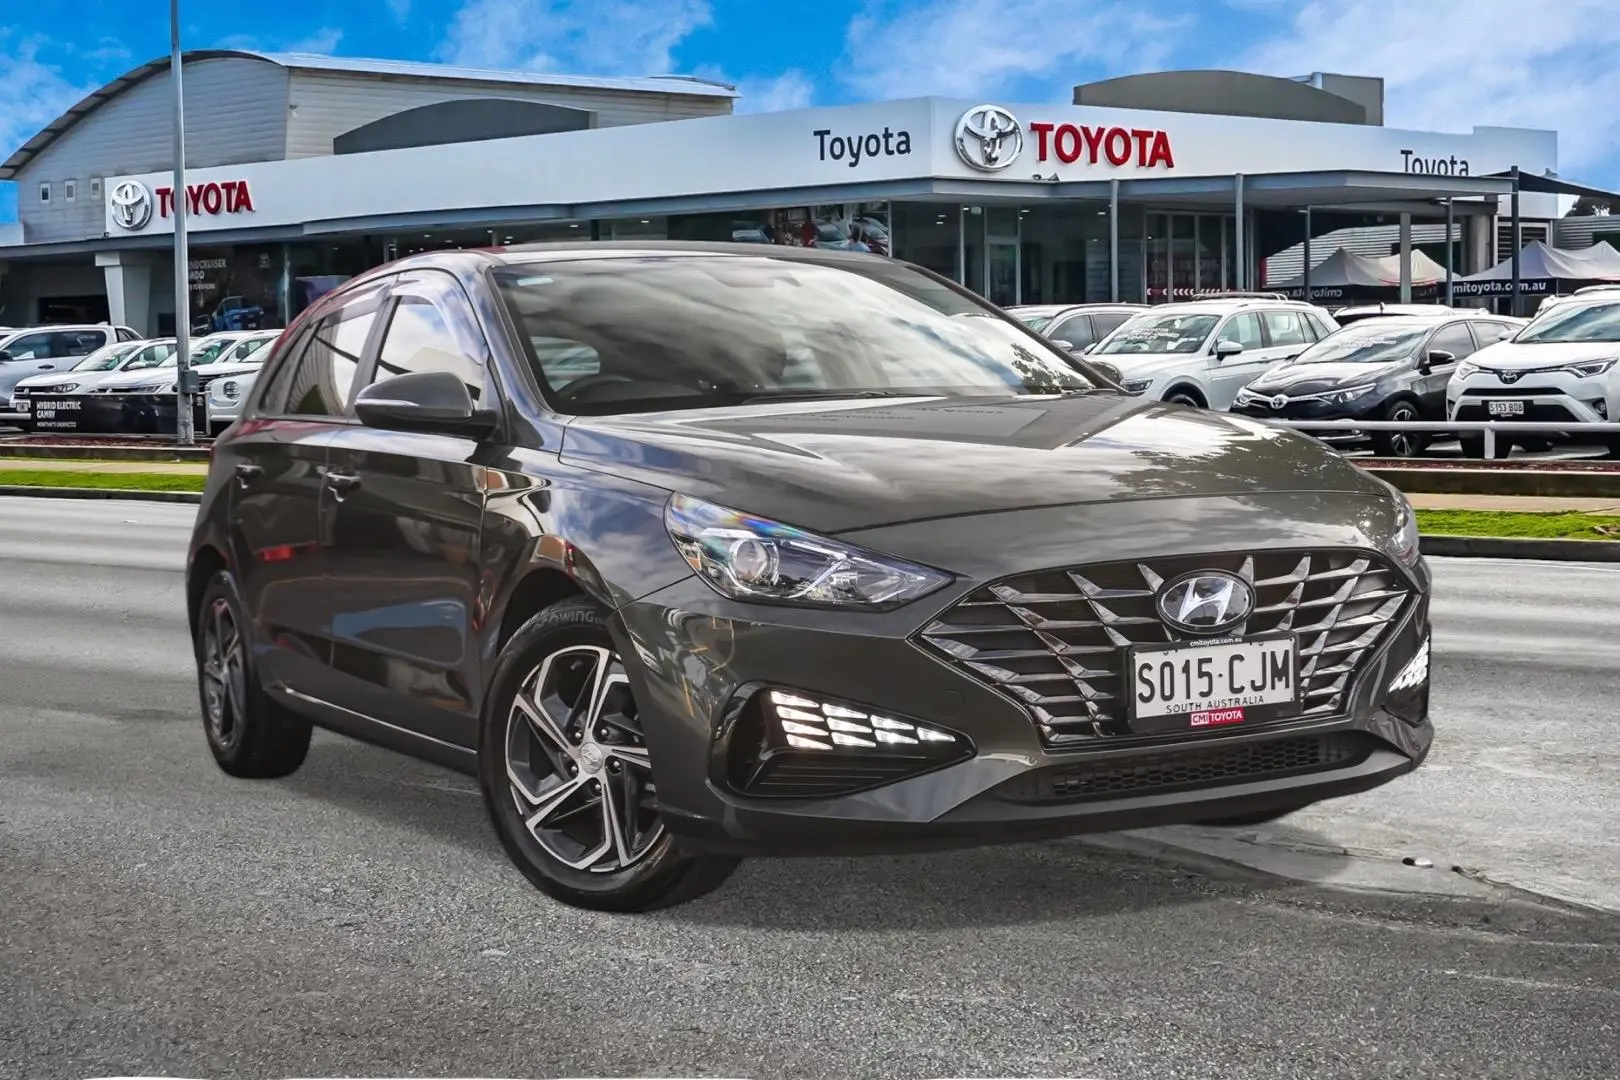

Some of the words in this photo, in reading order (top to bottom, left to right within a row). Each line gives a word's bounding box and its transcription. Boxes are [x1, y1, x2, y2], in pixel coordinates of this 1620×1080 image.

[813, 127, 911, 168] Toyota
[1030, 122, 1174, 168] TOYOTA
[1453, 281, 1547, 295] mitoyota.cm.au
[1190, 638, 1243, 647] cmitoyota.com.au
[1166, 702, 1201, 714] SOUTH
[1207, 695, 1265, 708] AUSTRALIA
[1210, 710, 1243, 722] TOYOTA
